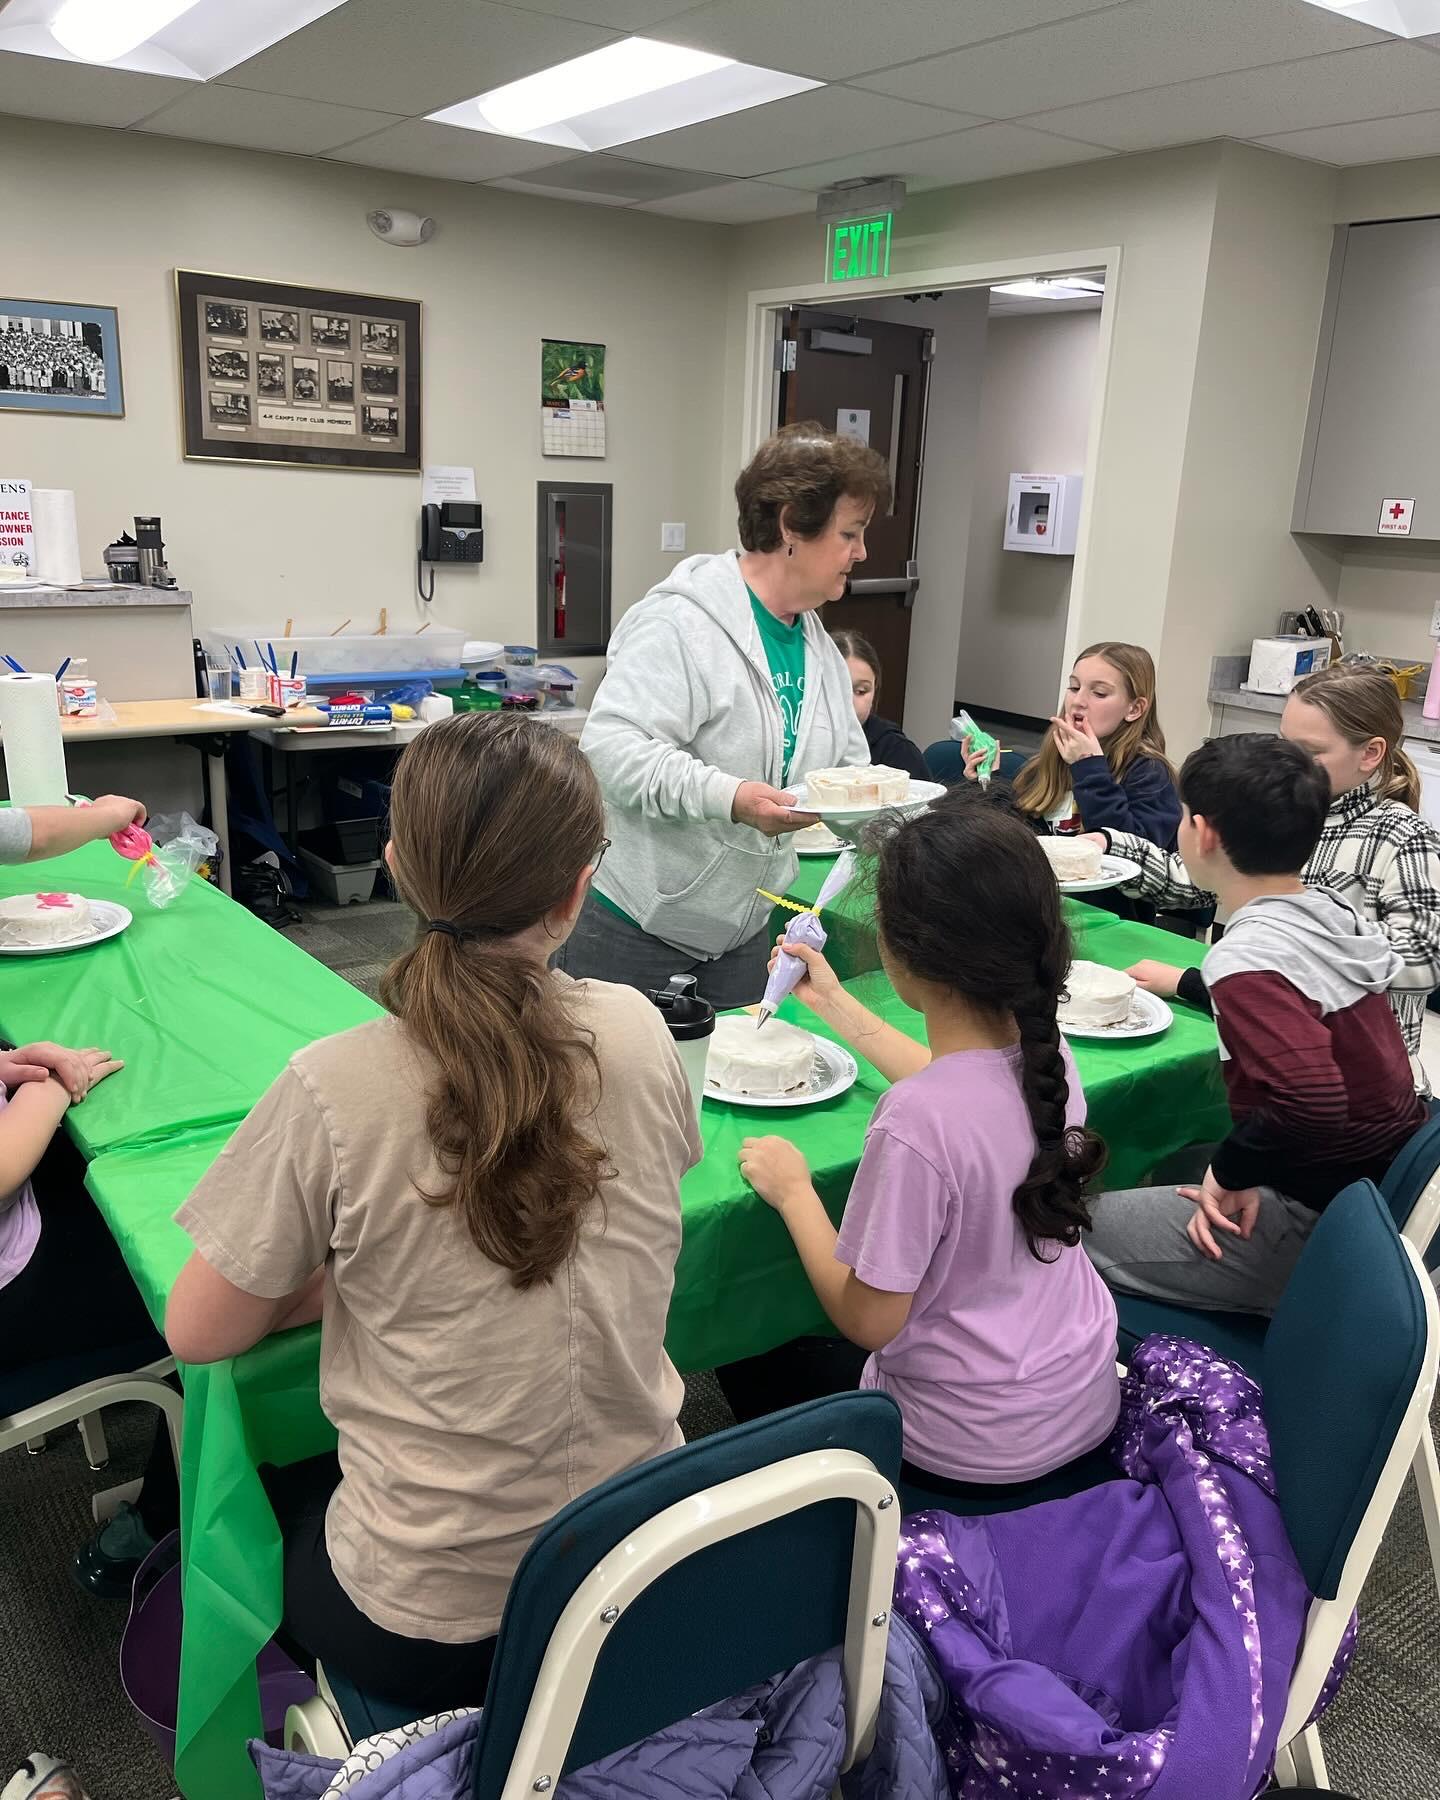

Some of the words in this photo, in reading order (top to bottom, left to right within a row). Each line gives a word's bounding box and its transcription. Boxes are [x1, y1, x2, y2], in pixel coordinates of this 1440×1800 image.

[832, 221, 884, 280] EXIT
[275, 414, 294, 422] CAMPS
[327, 418, 352, 426] MEMBERS
[0, 511, 30, 521] TANCE
[0, 524, 33, 534] OWNER
